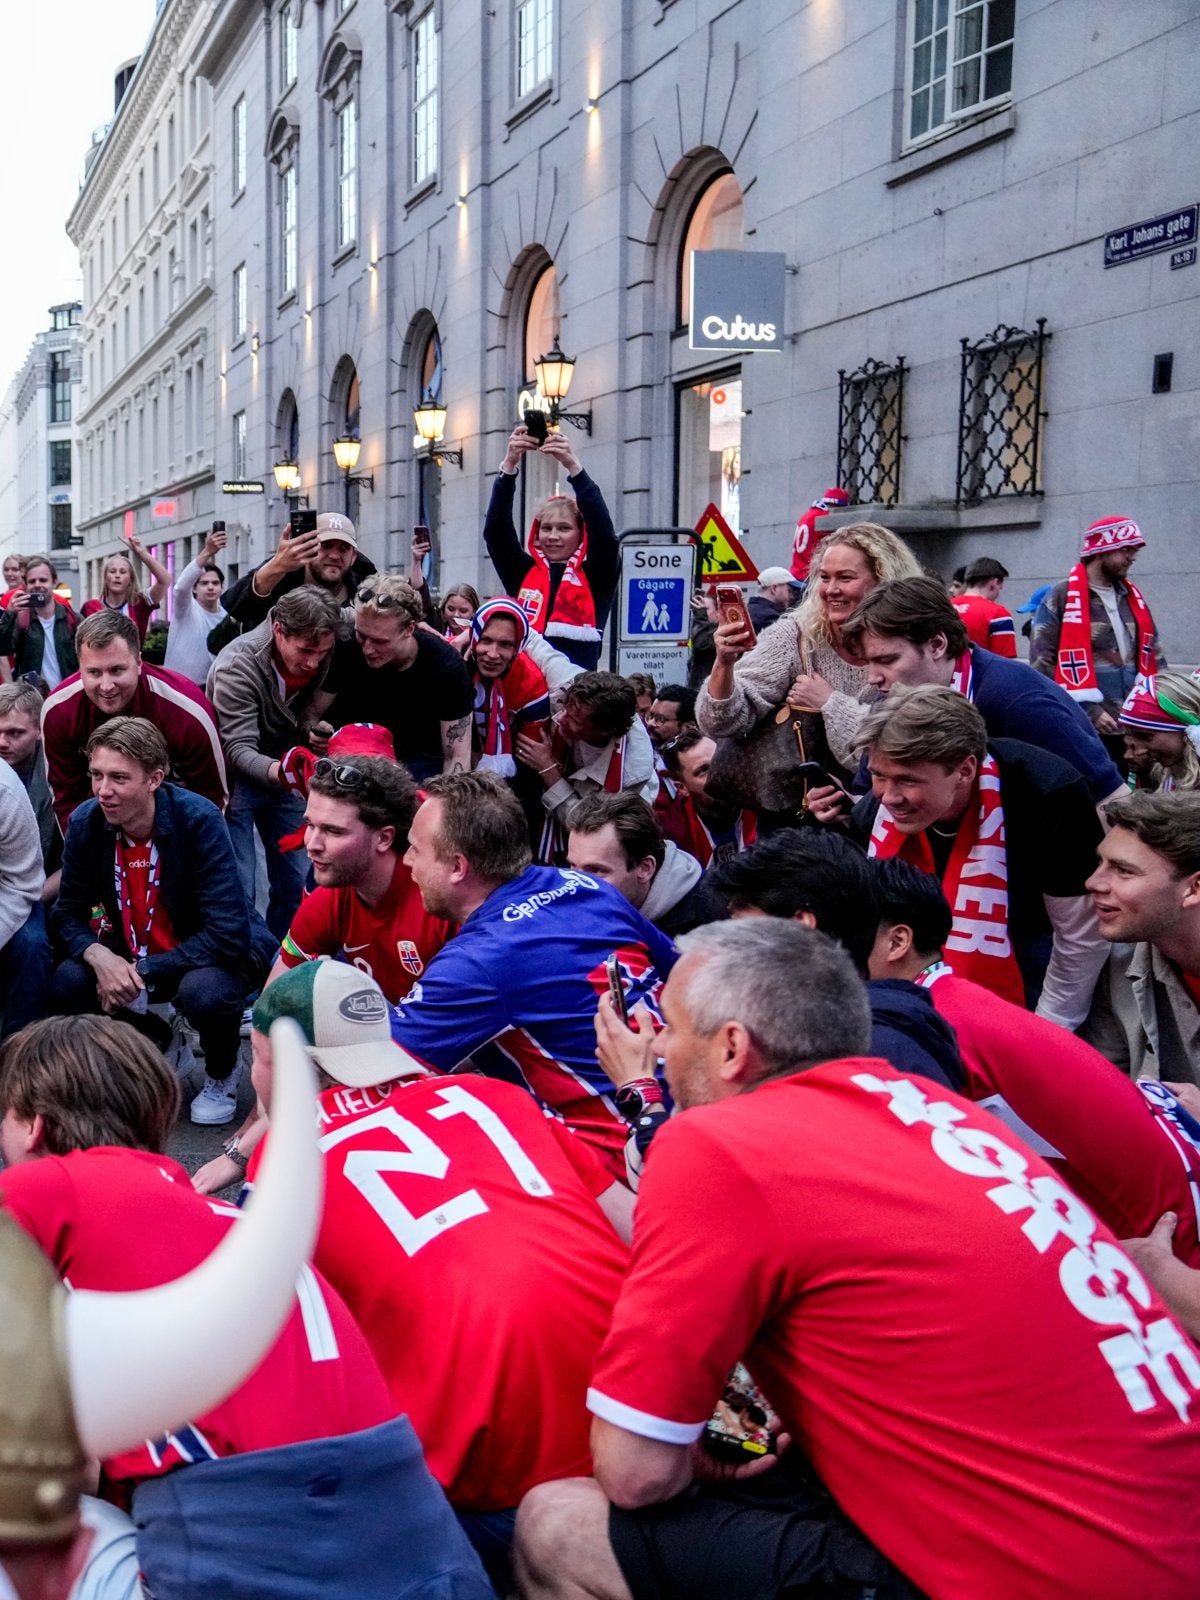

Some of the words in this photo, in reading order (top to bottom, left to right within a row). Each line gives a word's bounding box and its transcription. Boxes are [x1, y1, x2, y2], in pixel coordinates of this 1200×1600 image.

[1131, 224, 1164, 245] Johans
[1166, 214, 1190, 238] gate
[702, 314, 776, 342] Cubus
[634, 551, 682, 568] Sone
[638, 579, 676, 592] Gågate
[626, 650, 683, 661] Varetransport
[643, 661, 665, 670] tillatt
[850, 1073, 1200, 1425] NORGE
